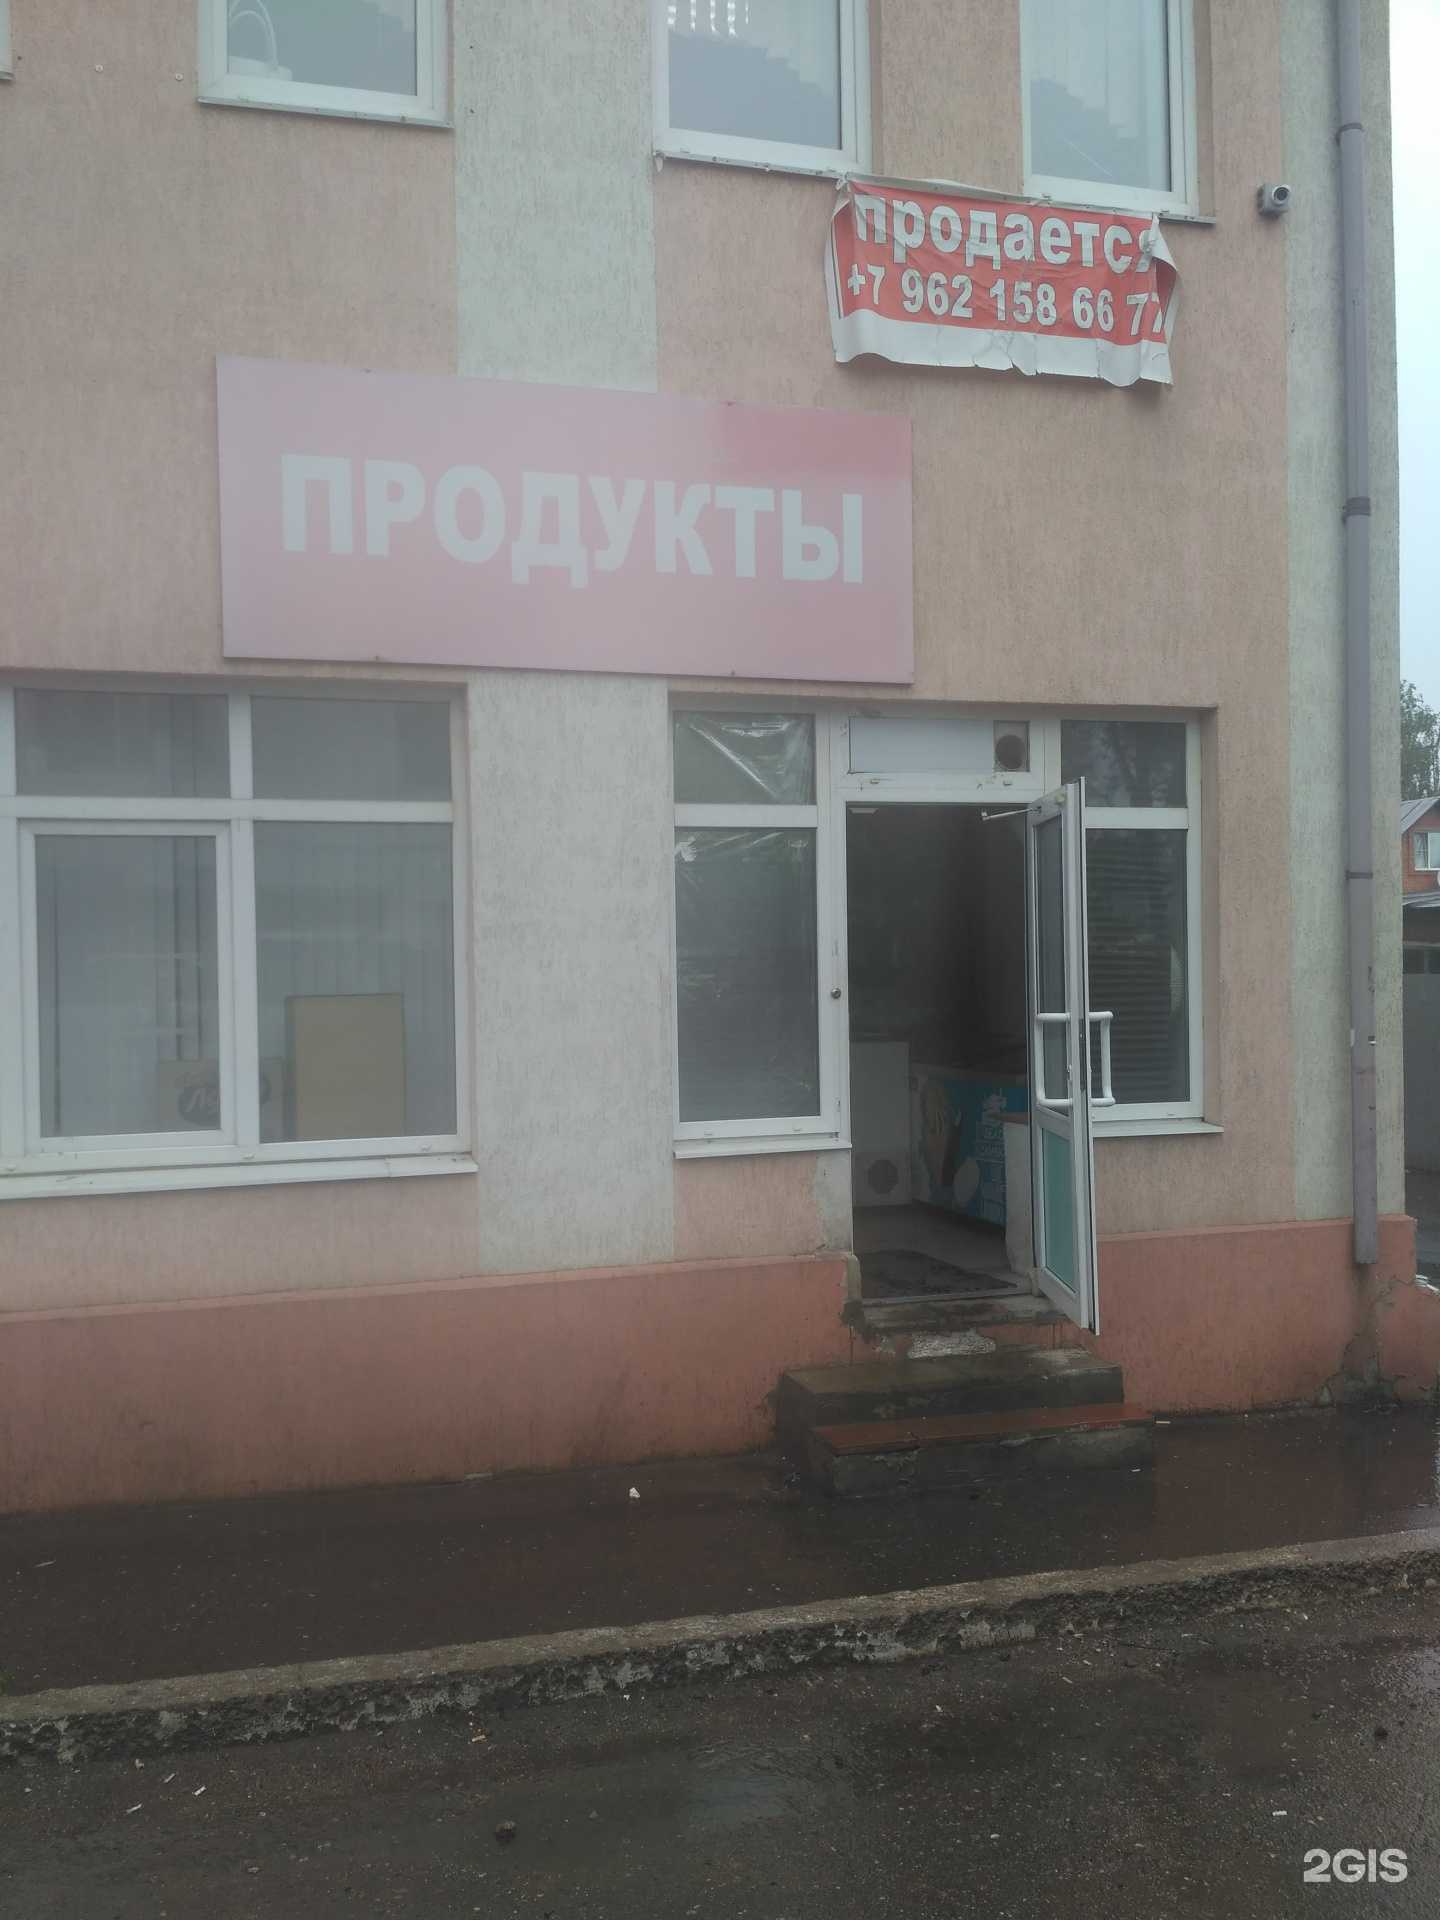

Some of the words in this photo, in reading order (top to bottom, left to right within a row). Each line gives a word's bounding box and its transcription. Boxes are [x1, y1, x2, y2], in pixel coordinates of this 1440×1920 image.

[848, 263, 885, 305] +7
[902, 268, 972, 318] 962
[990, 278, 1057, 326] 158
[1072, 287, 1114, 332] 66
[281, 453, 863, 588] ПРОДУКТЫ
